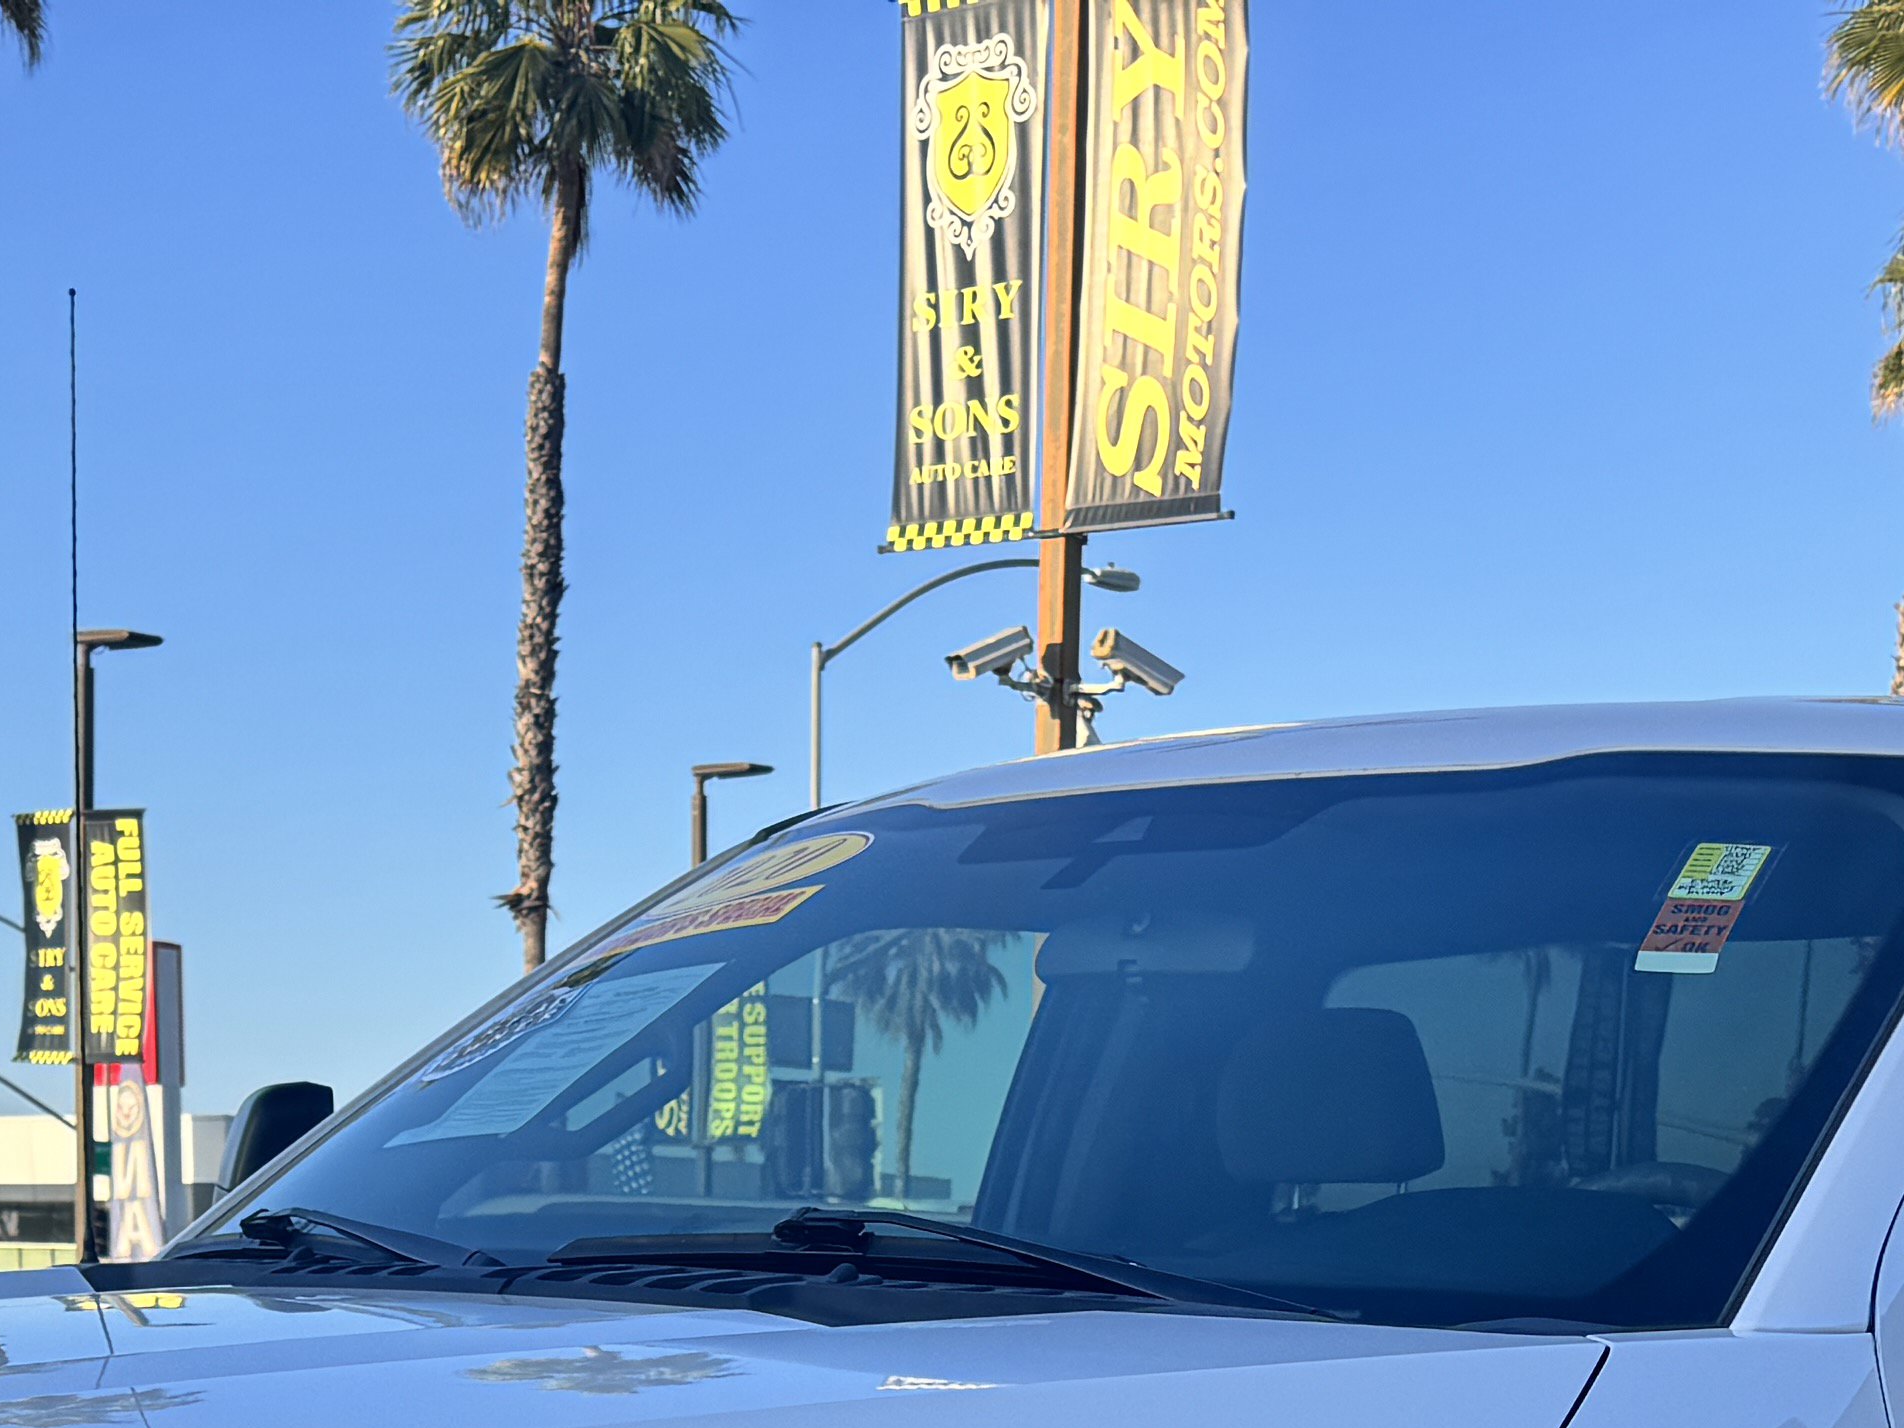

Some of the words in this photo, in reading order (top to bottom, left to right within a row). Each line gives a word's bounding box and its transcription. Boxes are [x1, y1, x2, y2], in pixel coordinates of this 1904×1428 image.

[1094, 0, 1186, 498] SIRY
[912, 279, 1023, 332] SIRY
[948, 345, 983, 380] &
[909, 394, 1020, 443] SONS
[909, 462, 962, 485] AUTO
[963, 456, 1016, 479] CARE
[90, 841, 117, 936] AUTO
[115, 818, 143, 897] FULL
[1652, 924, 1729, 937] SAFETY
[1671, 904, 1732, 916] SMOG
[90, 943, 117, 1033] CARE
[115, 911, 144, 1056] SERVICE
[709, 1021, 740, 1137] TROOPS
[737, 1003, 767, 1138] SUPPORT
